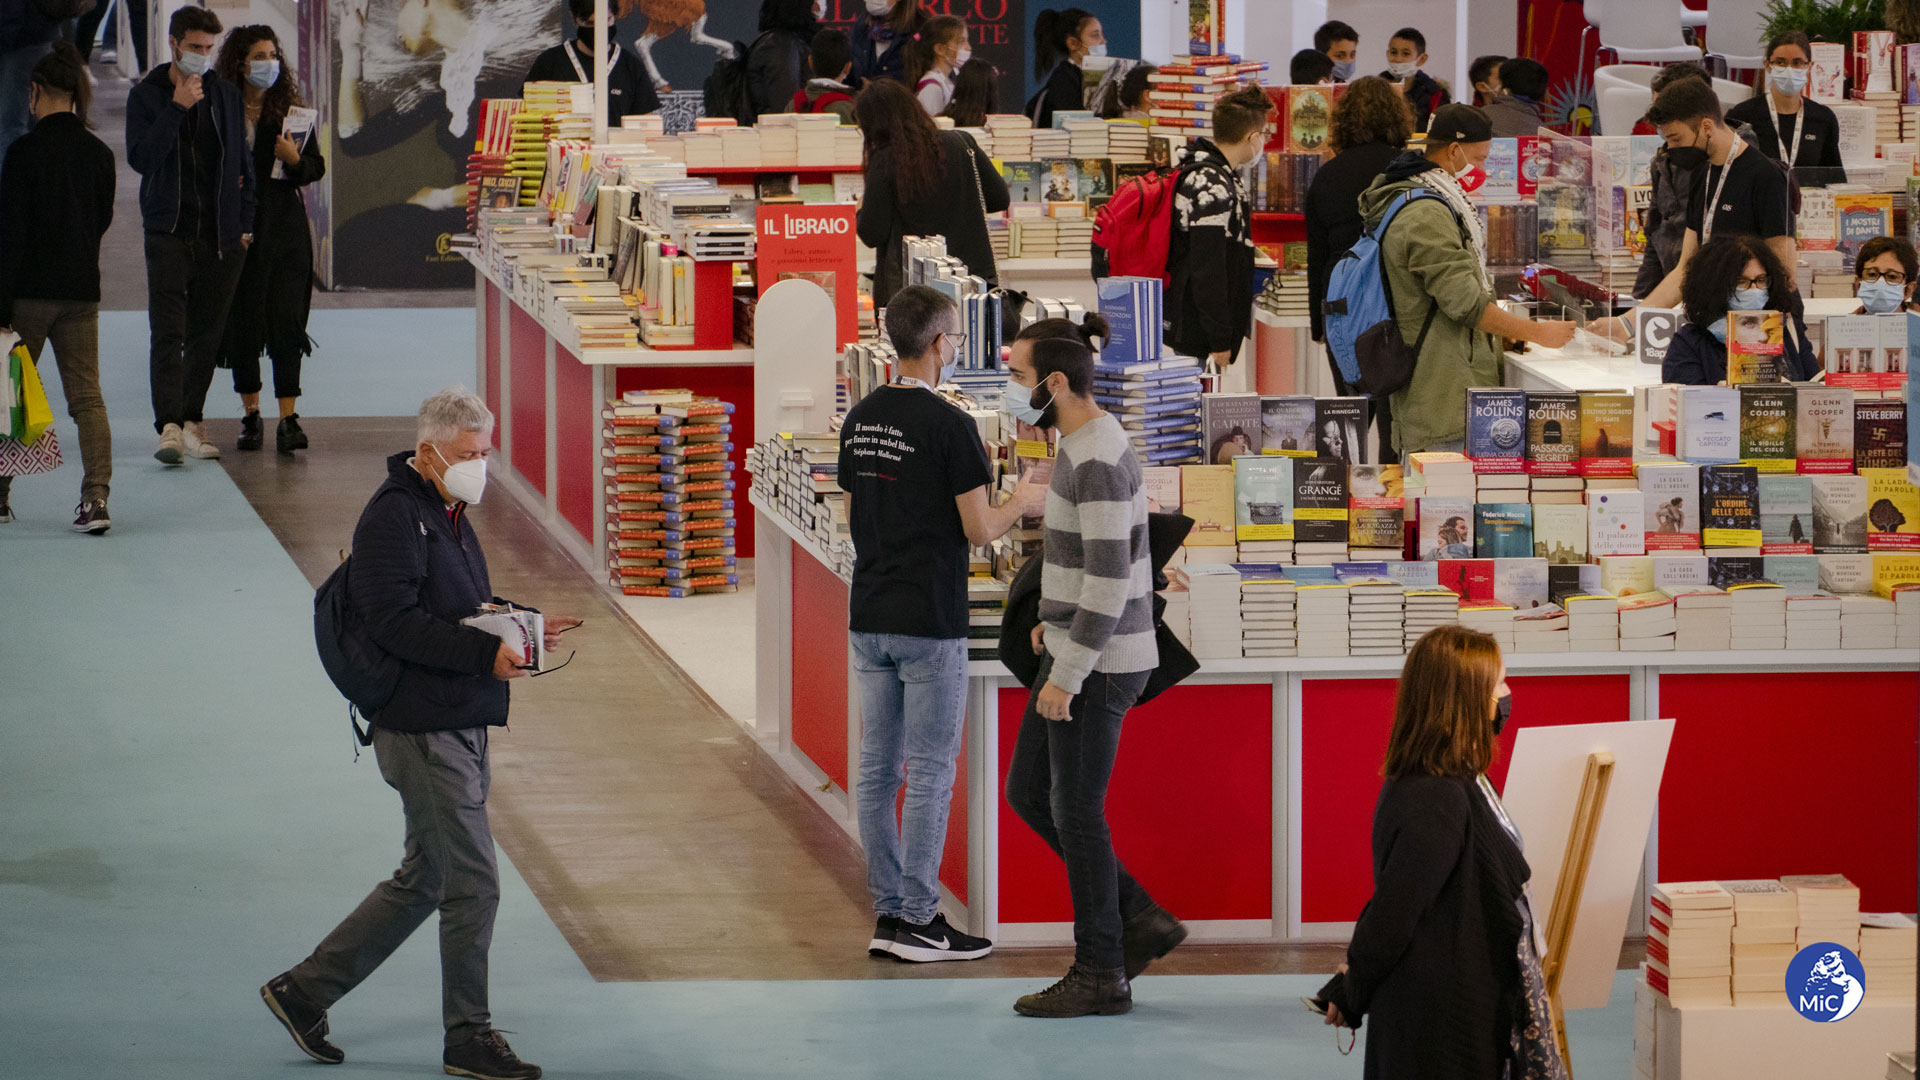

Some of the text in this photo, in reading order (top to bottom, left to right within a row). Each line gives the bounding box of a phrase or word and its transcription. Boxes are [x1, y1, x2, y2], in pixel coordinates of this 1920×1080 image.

[764, 213, 849, 239] IL LIBRAIO
[1845, 217, 1881, 227] I MOSTRI
[1846, 226, 1881, 236] DI DANTE
[1486, 399, 1512, 407] JAMES
[1538, 402, 1566, 410] JAMES
[1476, 406, 1523, 417] ROLLINS
[1528, 409, 1577, 420] ROLLINS
[1856, 410, 1904, 420] STEVE BERRY
[1212, 418, 1260, 429] CAPOTE
[855, 423, 903, 437] Il mondo è fatto
[845, 439, 853, 447] per
[853, 435, 871, 444] finire
[880, 438, 888, 446] un
[888, 439, 898, 448] bel
[898, 441, 915, 452] libro
[1530, 444, 1574, 453] PASSAGGI
[1535, 453, 1569, 462] SEGRETI
[1299, 484, 1342, 495] GRANGÉ
[1715, 500, 1748, 508] L'ORDINE
[1711, 508, 1753, 516] DELLE COSE
[1607, 532, 1639, 541] palazzo
[1594, 541, 1615, 549] delle
